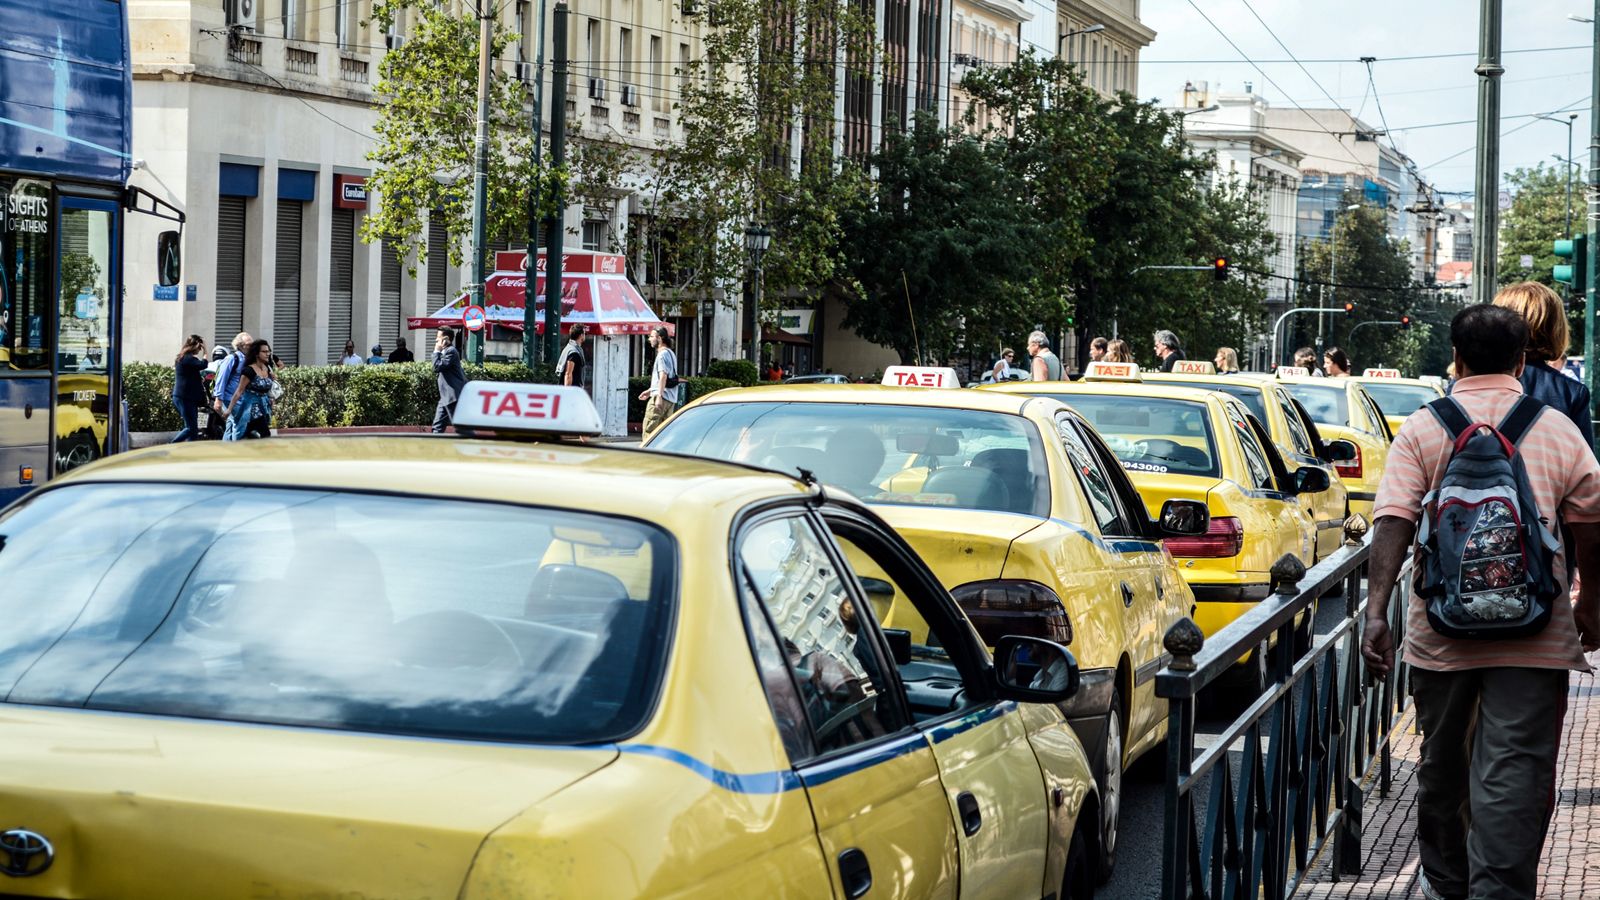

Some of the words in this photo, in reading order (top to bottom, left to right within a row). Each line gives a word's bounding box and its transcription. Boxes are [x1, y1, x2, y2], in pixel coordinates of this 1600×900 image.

[345, 186, 366, 199] Eurobank
[8, 193, 48, 217] SIGHTS
[8, 217, 19, 231] OF
[20, 219, 48, 234] ATHENS
[1094, 365, 1131, 377] ΤΑΞΙ
[1180, 363, 1206, 374] TAXI
[1368, 370, 1397, 379] ΤΑΞΙ
[893, 371, 943, 388] ΤΑΞΙ
[73, 389, 96, 402] TICKETS
[478, 390, 561, 419] ΤΑΞΙ
